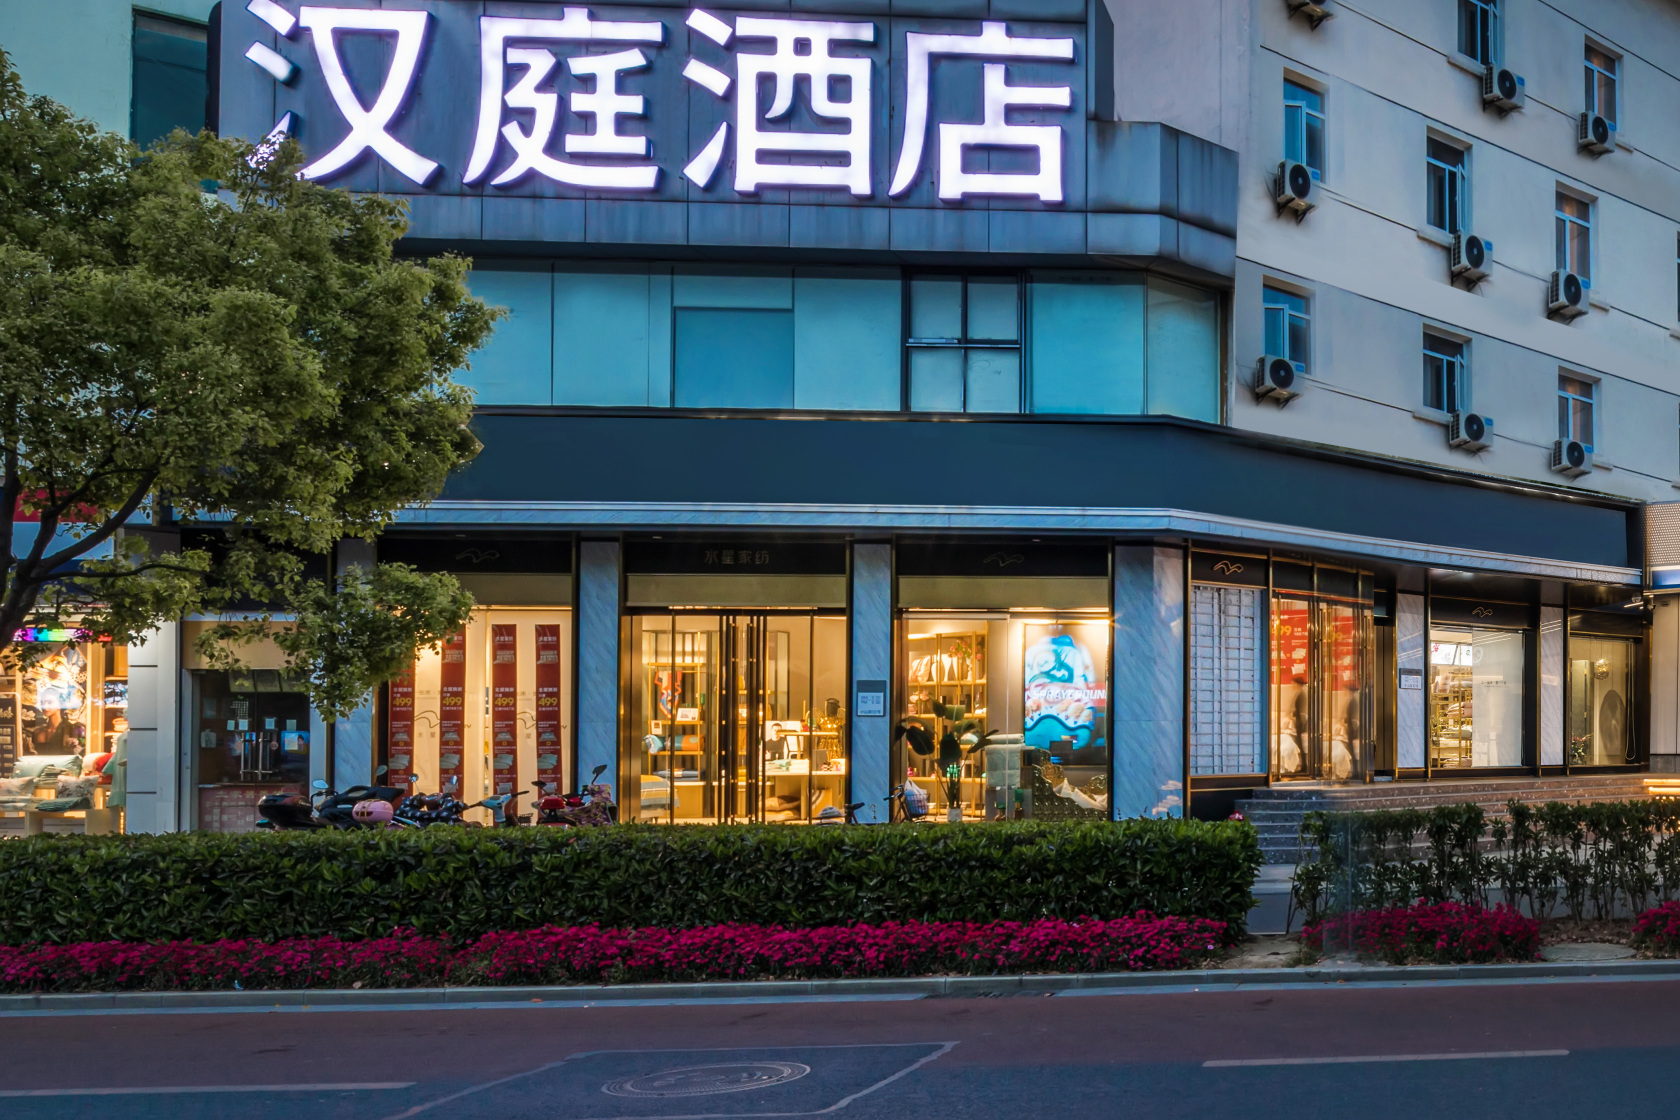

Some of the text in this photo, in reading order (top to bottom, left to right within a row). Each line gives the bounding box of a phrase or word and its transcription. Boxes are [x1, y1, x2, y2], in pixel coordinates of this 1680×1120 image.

[704, 549, 769, 564] 水星家纺
[393, 697, 412, 706] 499
[443, 697, 462, 706] 499
[495, 697, 514, 706] 499
[538, 697, 558, 706] 499
